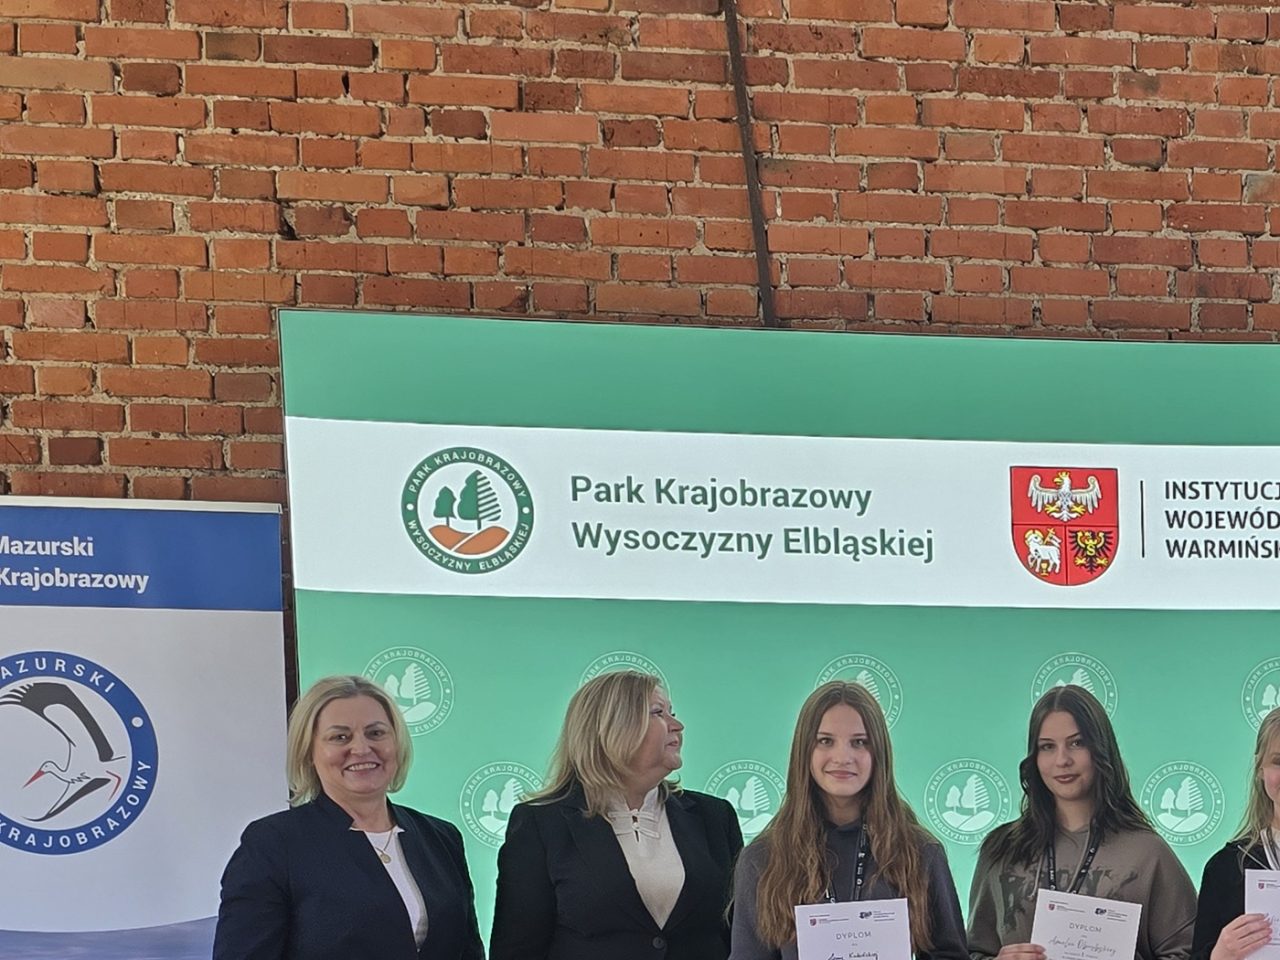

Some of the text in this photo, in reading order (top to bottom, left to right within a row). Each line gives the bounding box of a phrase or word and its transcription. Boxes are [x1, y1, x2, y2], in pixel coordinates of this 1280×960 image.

[408, 451, 527, 498] PARK KRAJOBRAZOWY
[570, 475, 872, 516] Park Krajobrazowy
[407, 519, 472, 571] WYSOCZYZNY
[570, 522, 934, 564] Wysoczyzny Elbląskiej
[0, 656, 116, 693] AZURSKI
[836, 931, 871, 940] DYPLOM
[1069, 922, 1102, 933] DYPLOM
